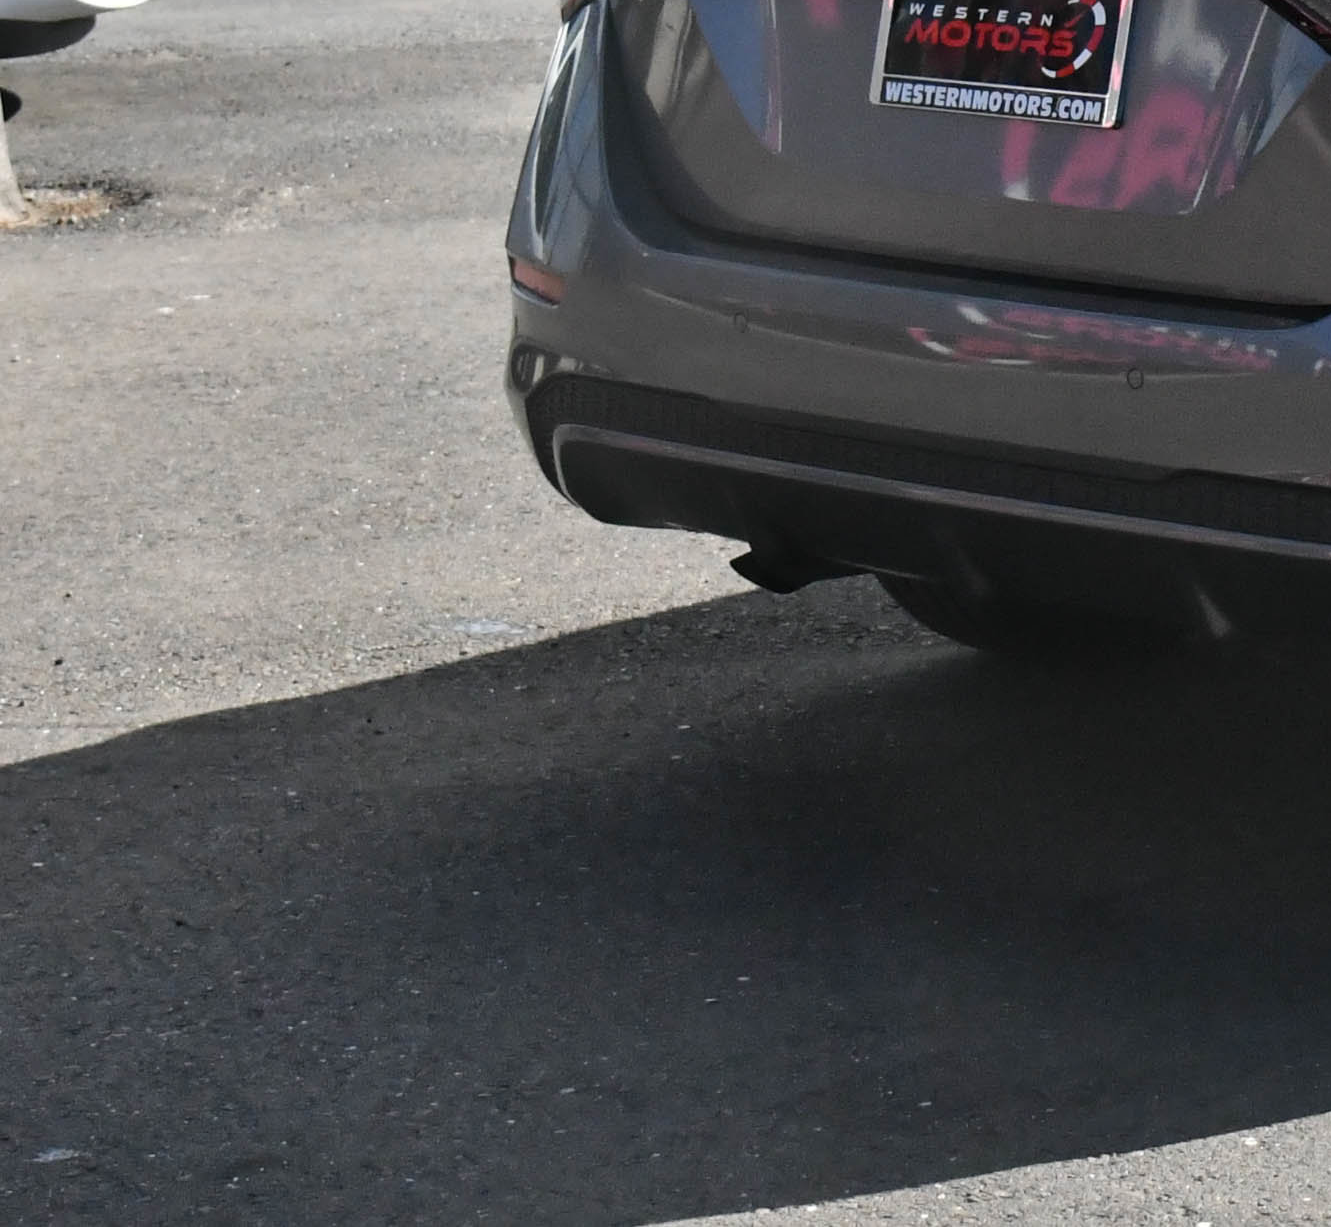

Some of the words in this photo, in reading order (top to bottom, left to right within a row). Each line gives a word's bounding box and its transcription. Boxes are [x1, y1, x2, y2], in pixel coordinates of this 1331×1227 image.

[909, 2, 1054, 27] WESTERN
[904, 17, 1077, 58] MOTORS
[885, 80, 1102, 122] WESTERNMOTORS.COM
